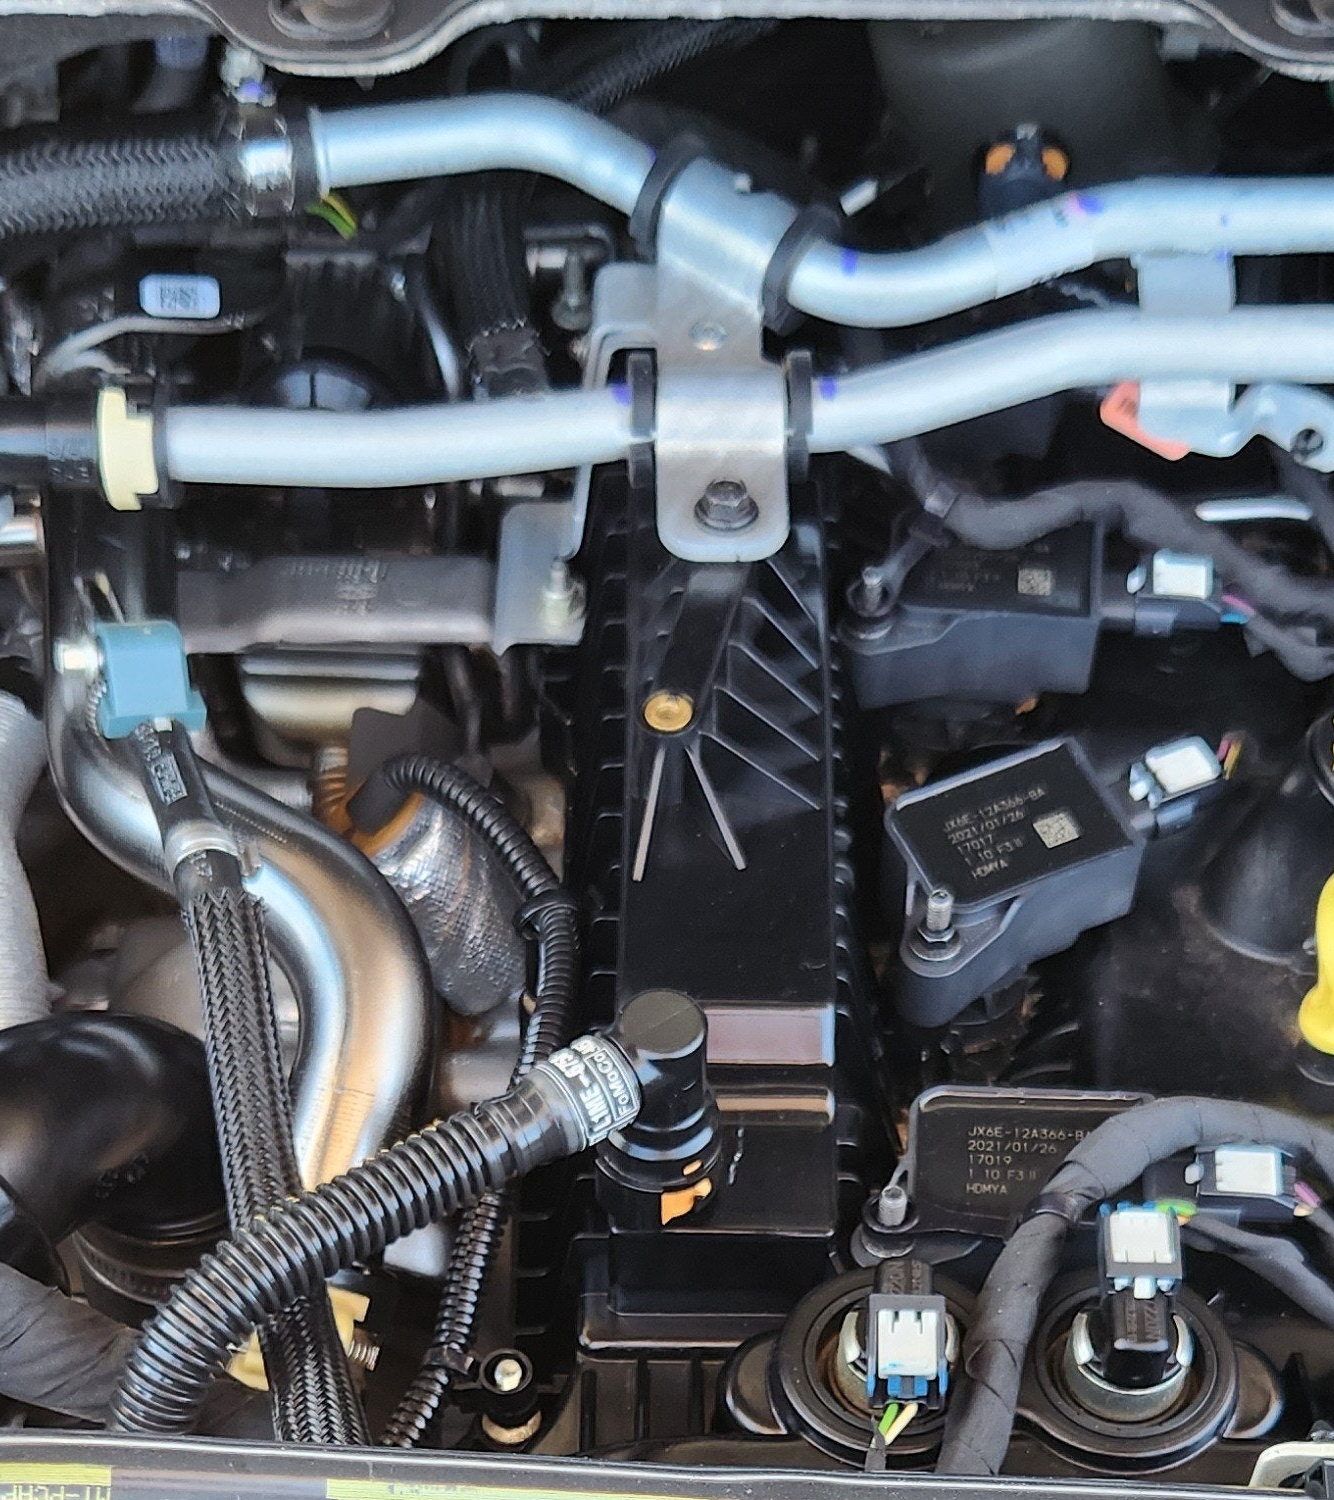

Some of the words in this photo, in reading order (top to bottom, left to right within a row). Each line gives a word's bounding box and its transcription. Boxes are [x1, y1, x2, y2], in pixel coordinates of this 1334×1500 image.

[968, 1140, 1057, 1154] 2021/01/26
[969, 1155, 1012, 1165] 17019
[967, 1183, 1007, 1195] HDMYA
